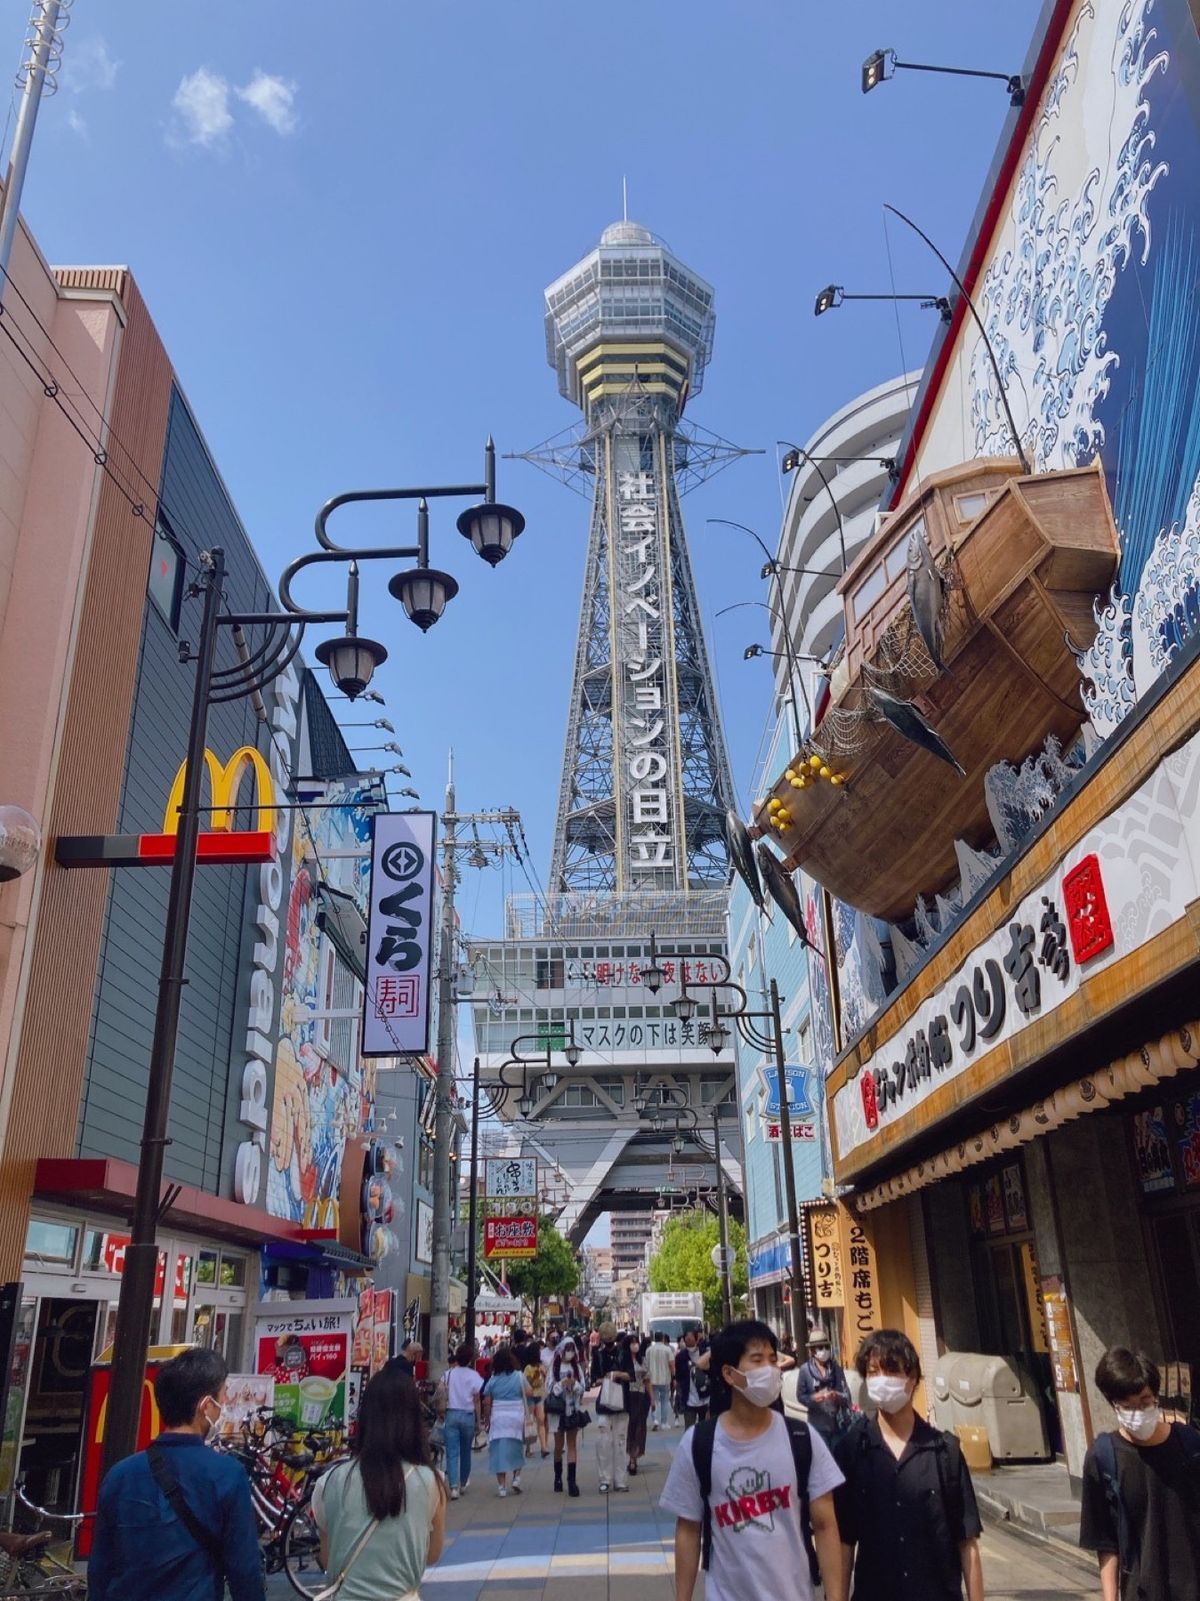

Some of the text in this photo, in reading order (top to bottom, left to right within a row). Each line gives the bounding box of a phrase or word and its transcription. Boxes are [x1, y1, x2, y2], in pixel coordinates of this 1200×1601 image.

[618, 473, 673, 868] 社会イノベーションの日立
[375, 881, 424, 972] くら
[379, 978, 417, 1014] 寿司
[582, 1021, 726, 1046] マスクの下は笑顔
[768, 1070, 805, 1079] LASON
[769, 1101, 809, 1111] STTION
[768, 1125, 814, 1139] 酒・ばこ
[815, 1243, 834, 1298] つり吉
[850, 1226, 874, 1345] 2階席もご
[714, 1485, 791, 1528] KIRBY
